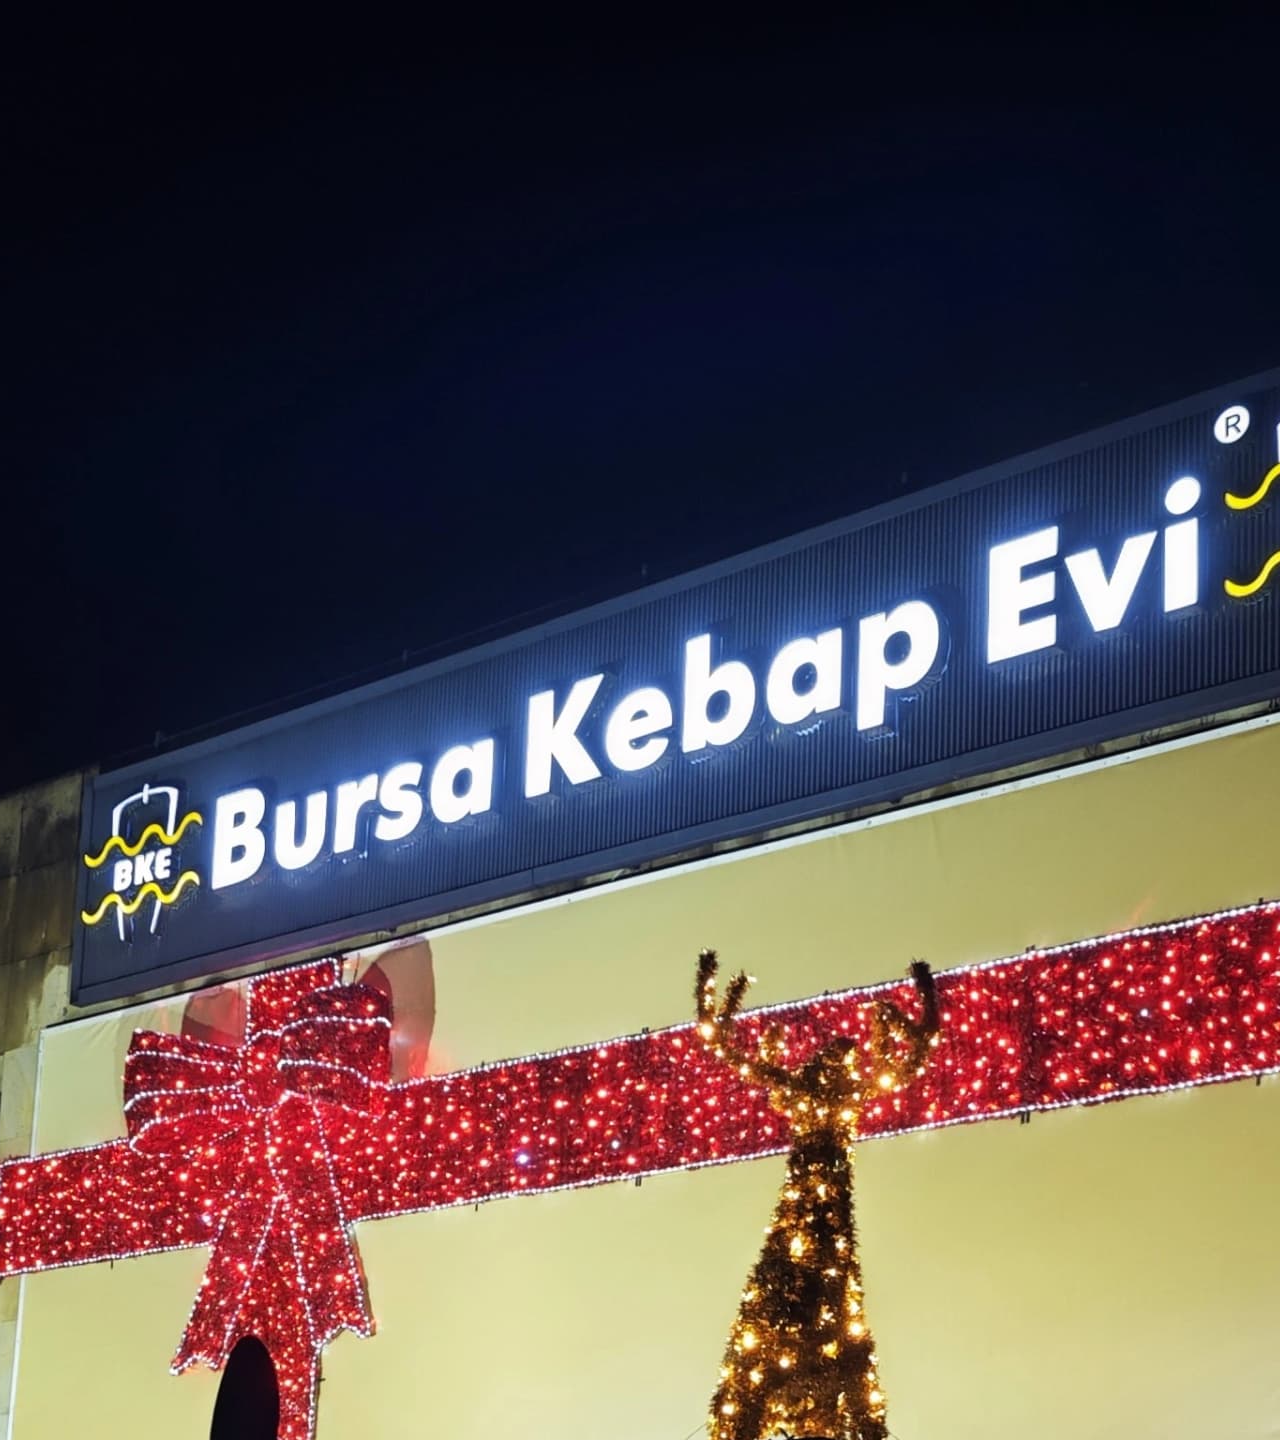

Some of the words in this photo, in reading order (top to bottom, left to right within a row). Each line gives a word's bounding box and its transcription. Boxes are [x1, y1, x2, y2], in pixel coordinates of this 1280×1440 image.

[212, 740, 494, 890] Bursa
[525, 600, 941, 799] Kebap
[987, 476, 1201, 663] Evi
[113, 847, 172, 892] BKE
